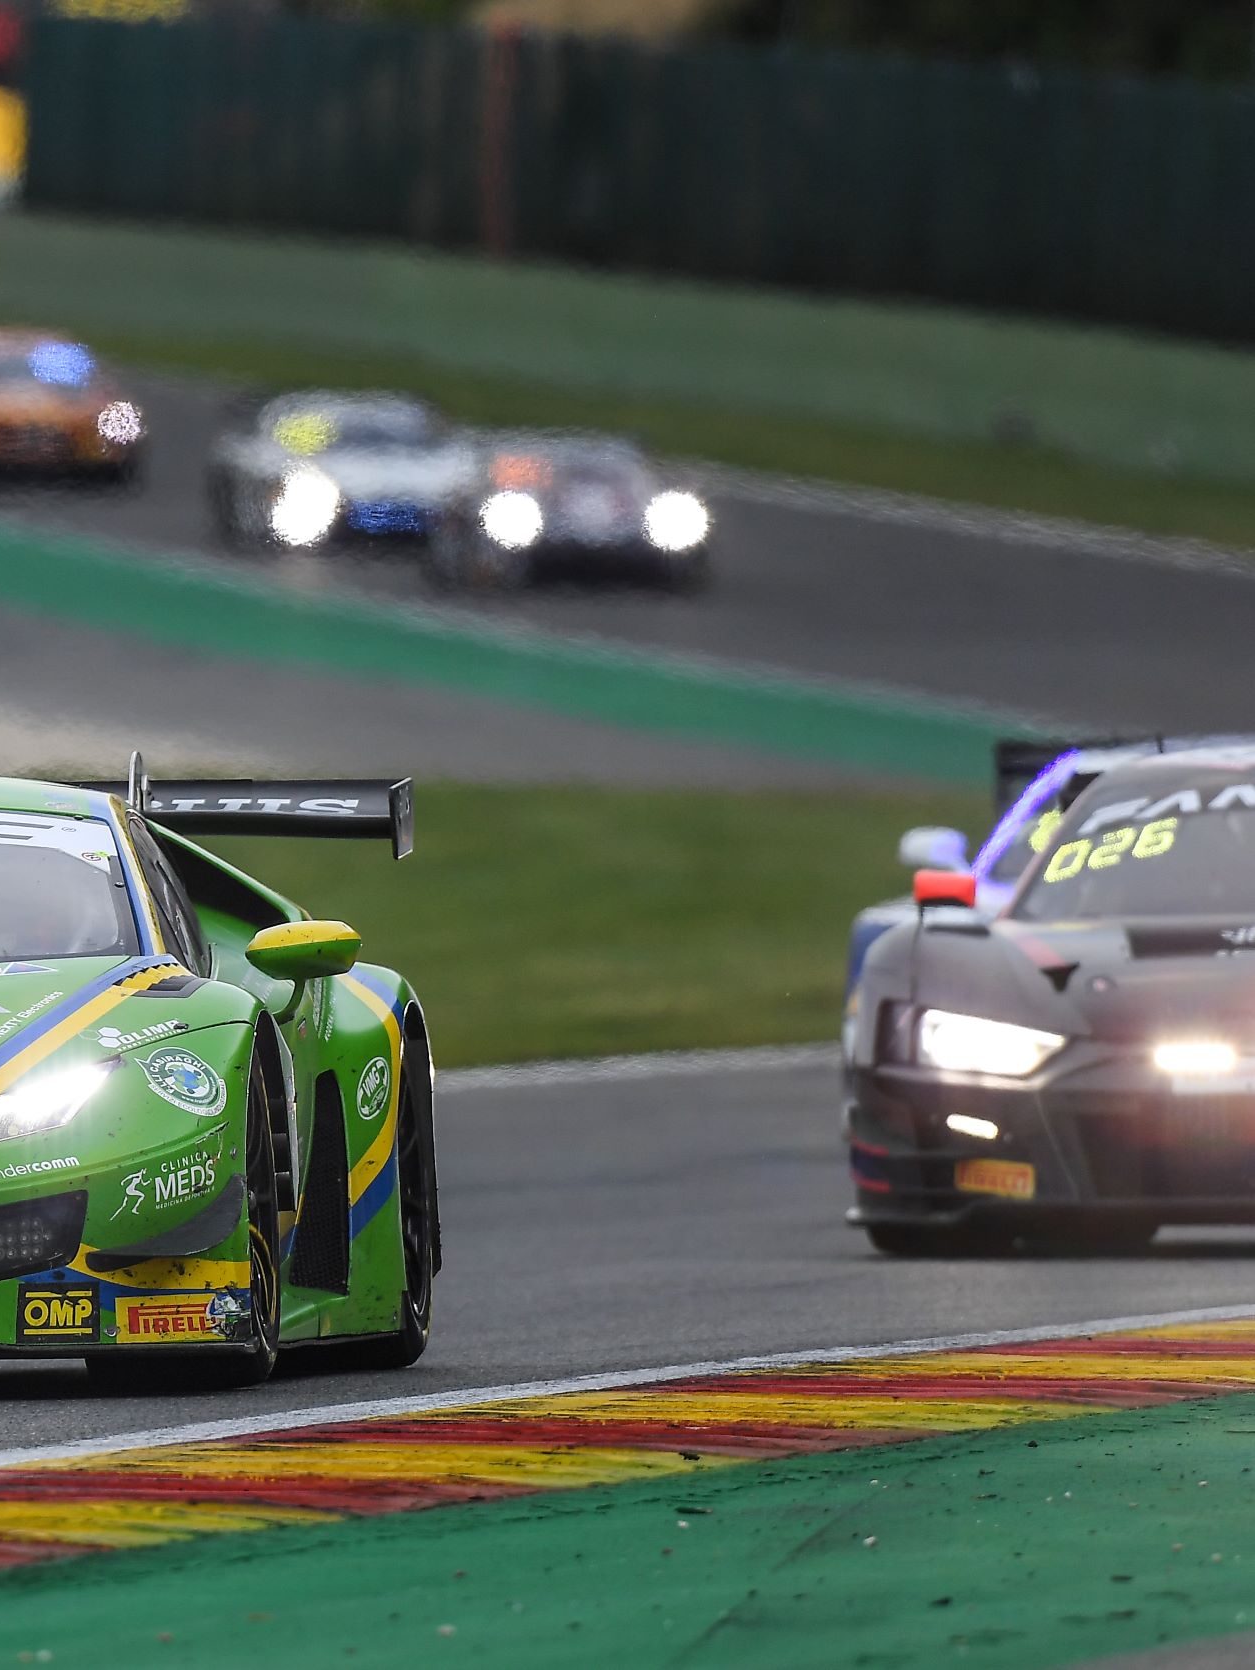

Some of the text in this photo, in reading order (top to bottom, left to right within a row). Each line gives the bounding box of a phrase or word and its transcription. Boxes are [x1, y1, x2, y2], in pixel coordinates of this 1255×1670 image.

[1044, 817, 1178, 883] 026
[150, 1055, 206, 1073] CASIRAGHI
[362, 1066, 380, 1098] VMG
[161, 1151, 209, 1173] CLINICA
[154, 1159, 215, 1203] MEDS
[24, 1299, 93, 1328] OMP
[127, 1303, 217, 1335] PIRELL
